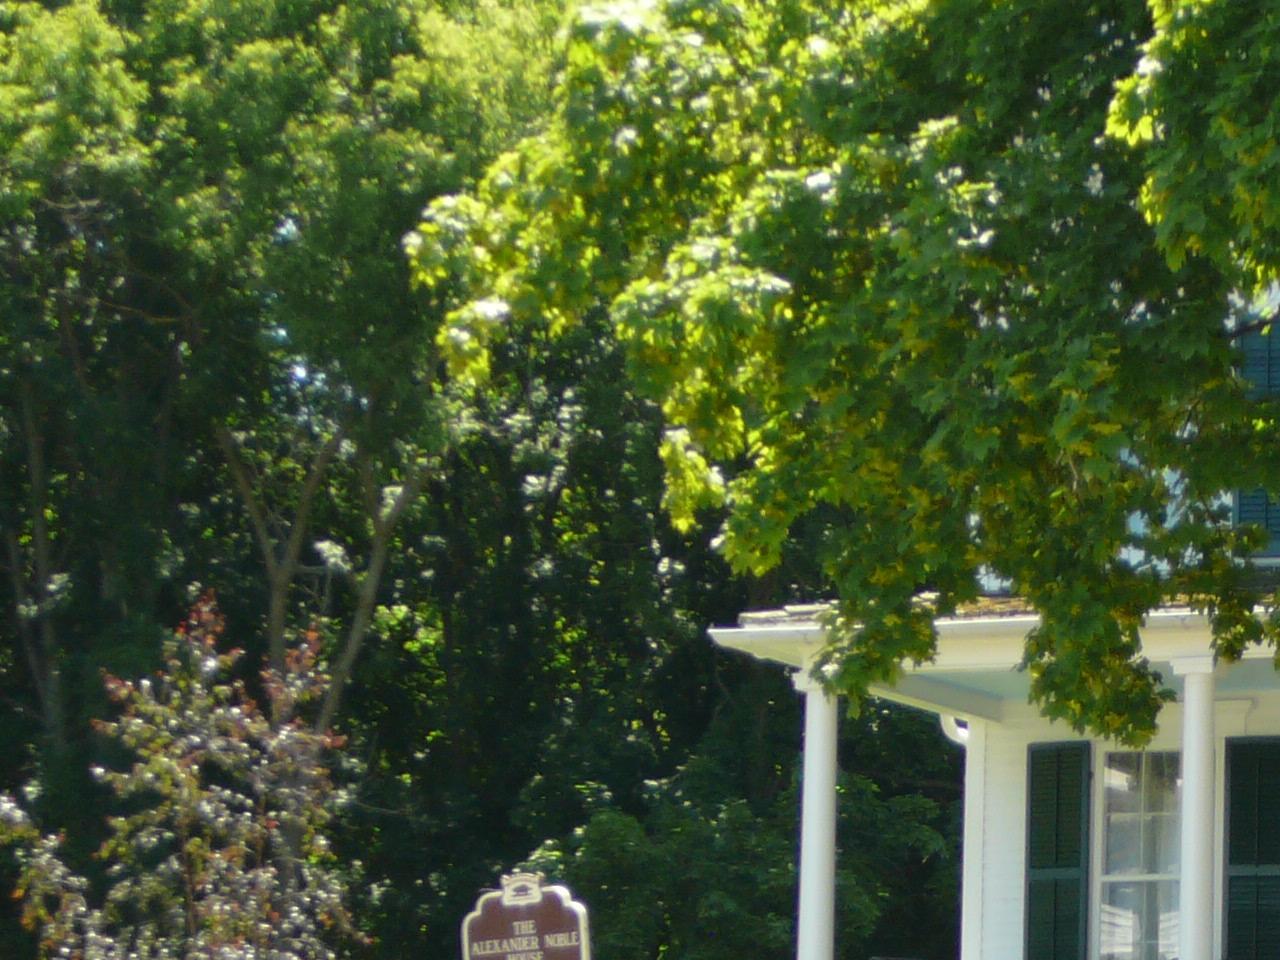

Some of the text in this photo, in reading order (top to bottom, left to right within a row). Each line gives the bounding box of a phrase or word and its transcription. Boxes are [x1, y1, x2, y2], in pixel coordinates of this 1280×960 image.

[512, 920, 536, 935] THE
[472, 930, 579, 955] ALEXANDER NOBLE
